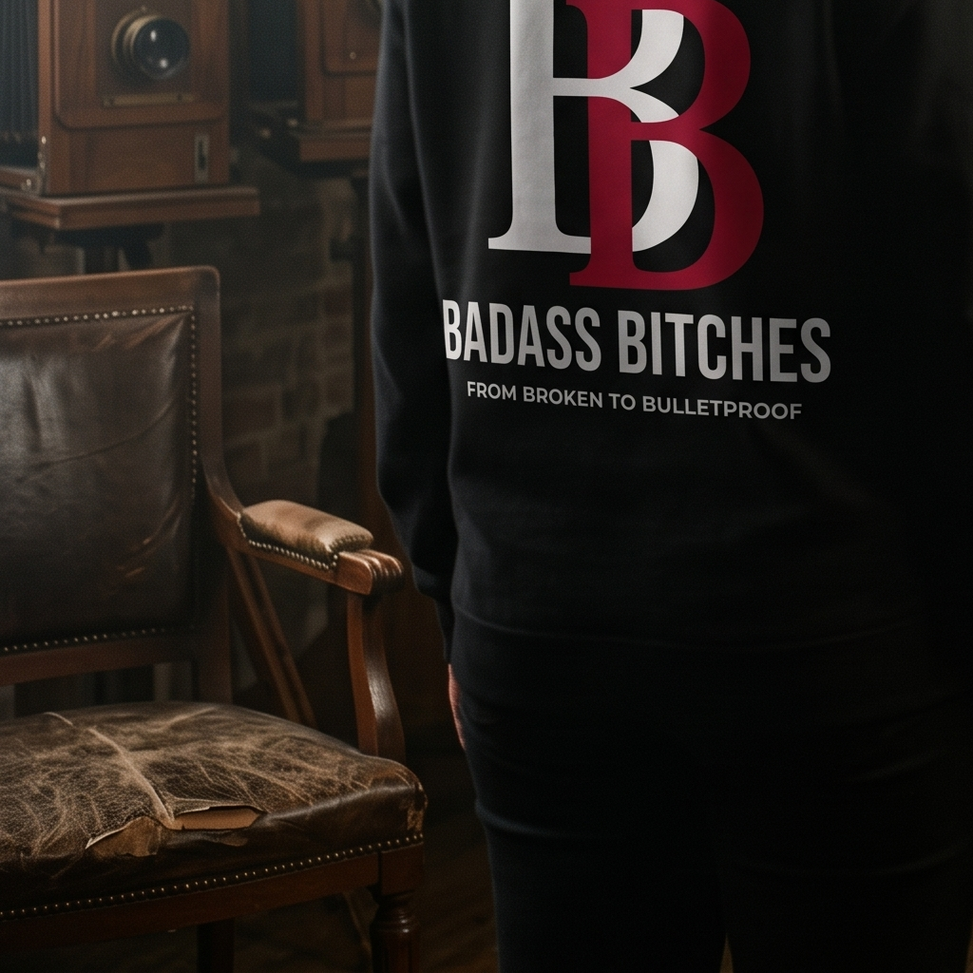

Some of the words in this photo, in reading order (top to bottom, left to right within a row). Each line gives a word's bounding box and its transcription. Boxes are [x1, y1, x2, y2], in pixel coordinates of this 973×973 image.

[442, 299, 601, 372] BADASS
[617, 310, 832, 383] BITCHES
[467, 381, 517, 401] FROM
[523, 387, 603, 409] BROKEN
[608, 393, 636, 411] TO
[642, 396, 802, 421] BULLETPROOF
